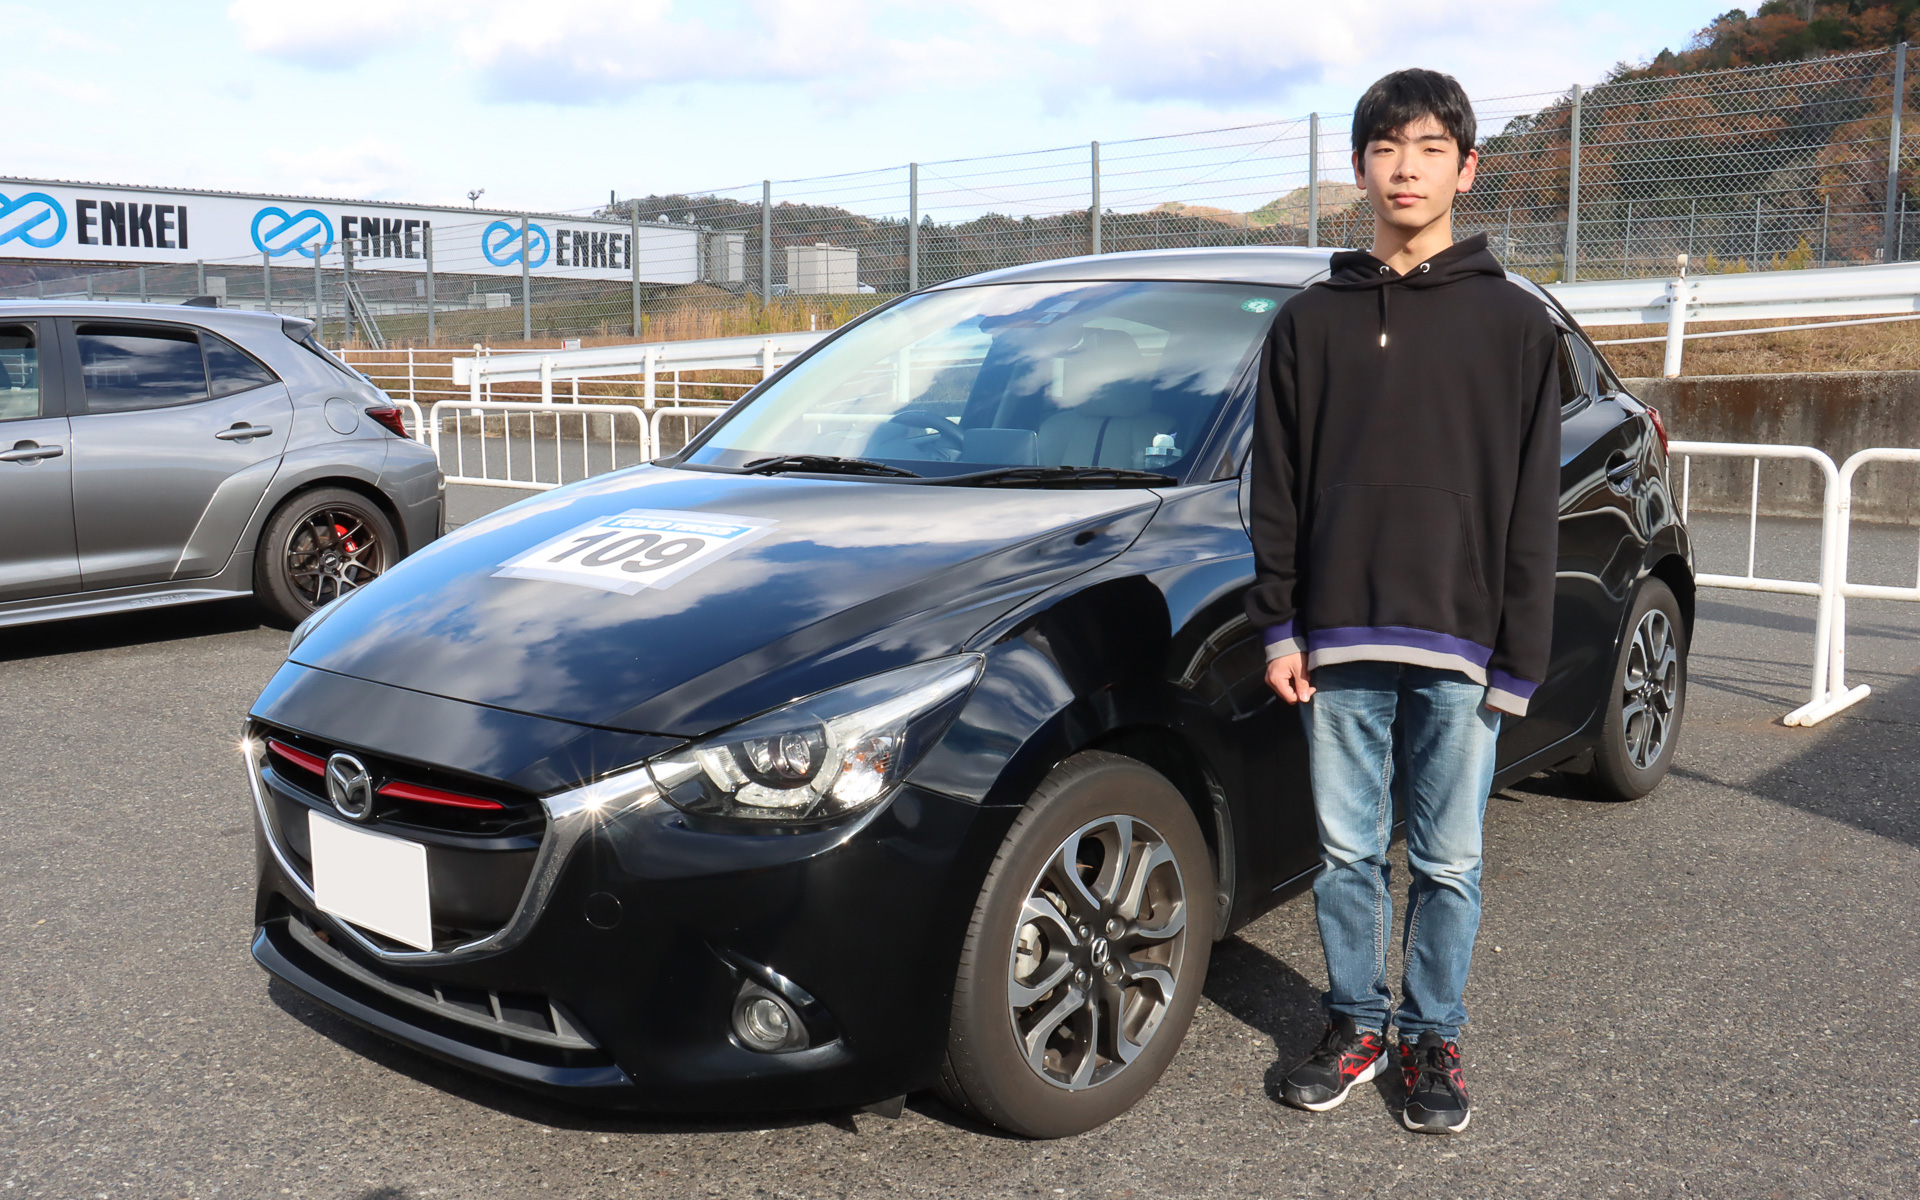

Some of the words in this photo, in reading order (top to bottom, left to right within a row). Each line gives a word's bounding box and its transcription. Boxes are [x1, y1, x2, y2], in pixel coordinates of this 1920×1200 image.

[76, 199, 188, 249] ENKEI
[341, 215, 430, 259] ENKEI
[556, 229, 631, 270] ENKEI
[608, 518, 673, 531] TOYO
[547, 531, 706, 573] 109
